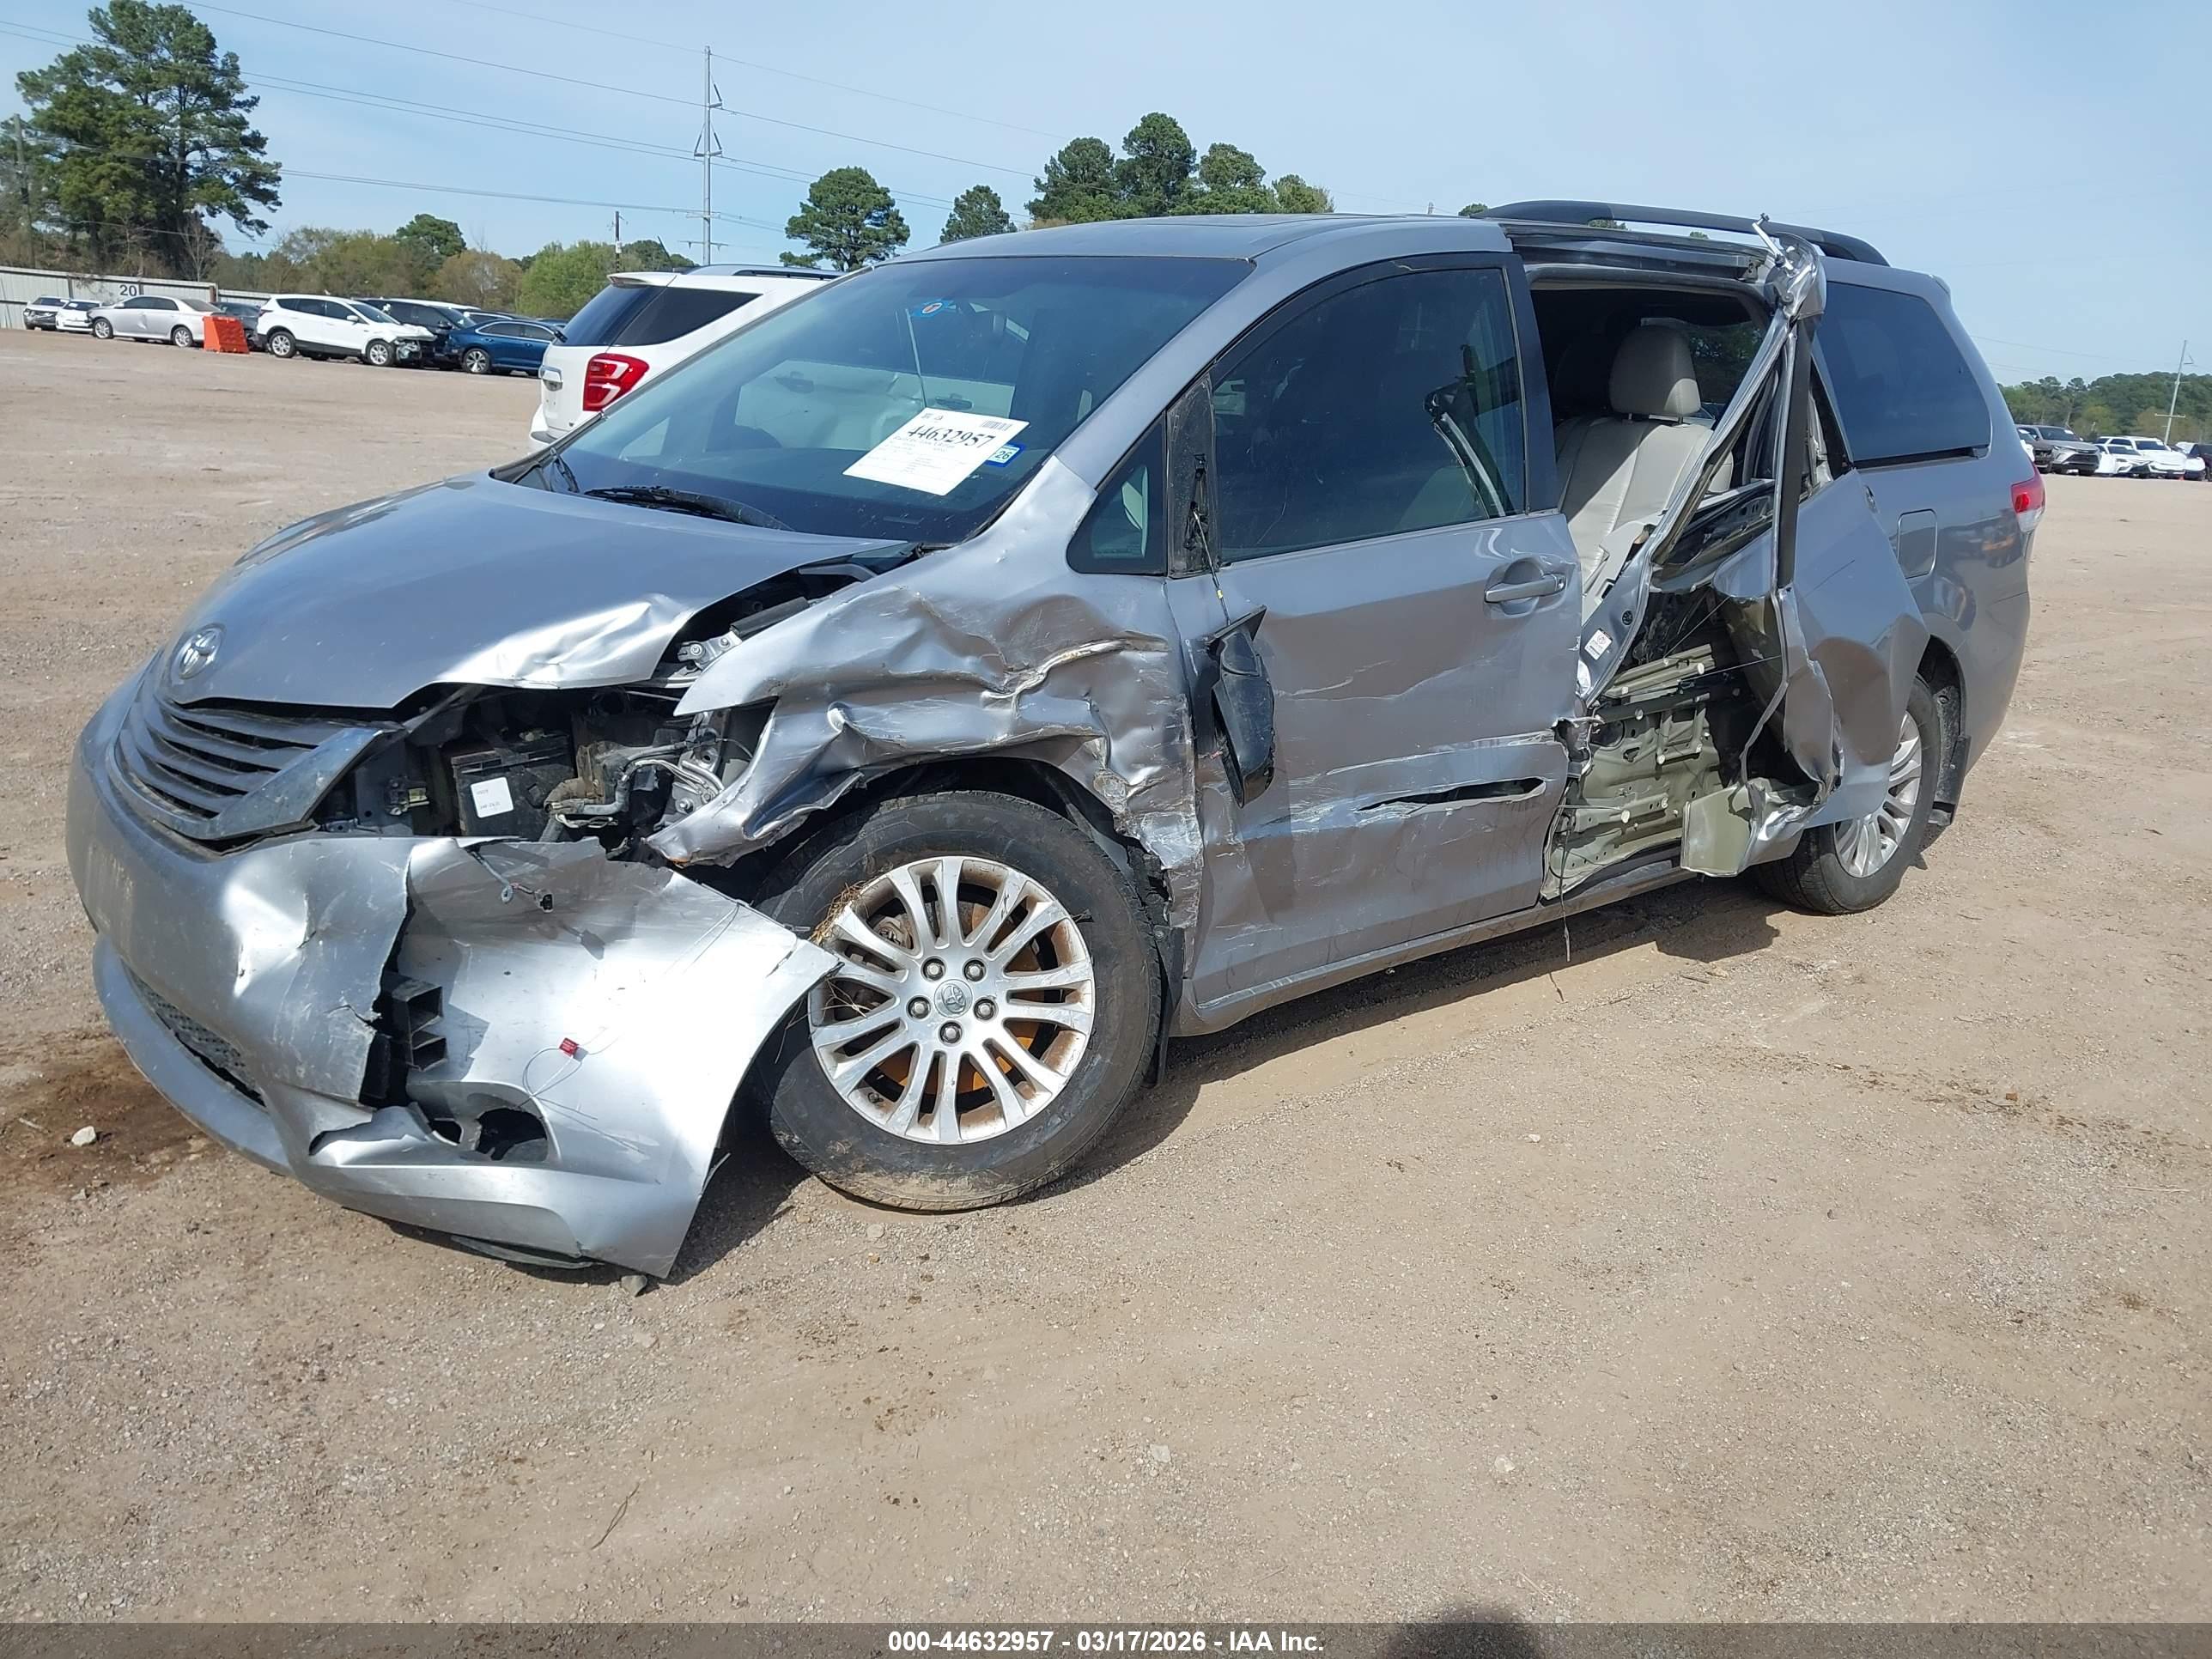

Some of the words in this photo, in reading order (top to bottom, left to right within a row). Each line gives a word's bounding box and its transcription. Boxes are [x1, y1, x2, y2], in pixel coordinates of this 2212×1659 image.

[119, 284, 137, 296] 20
[908, 424, 997, 449] 44632957
[994, 451, 1012, 460] 26
